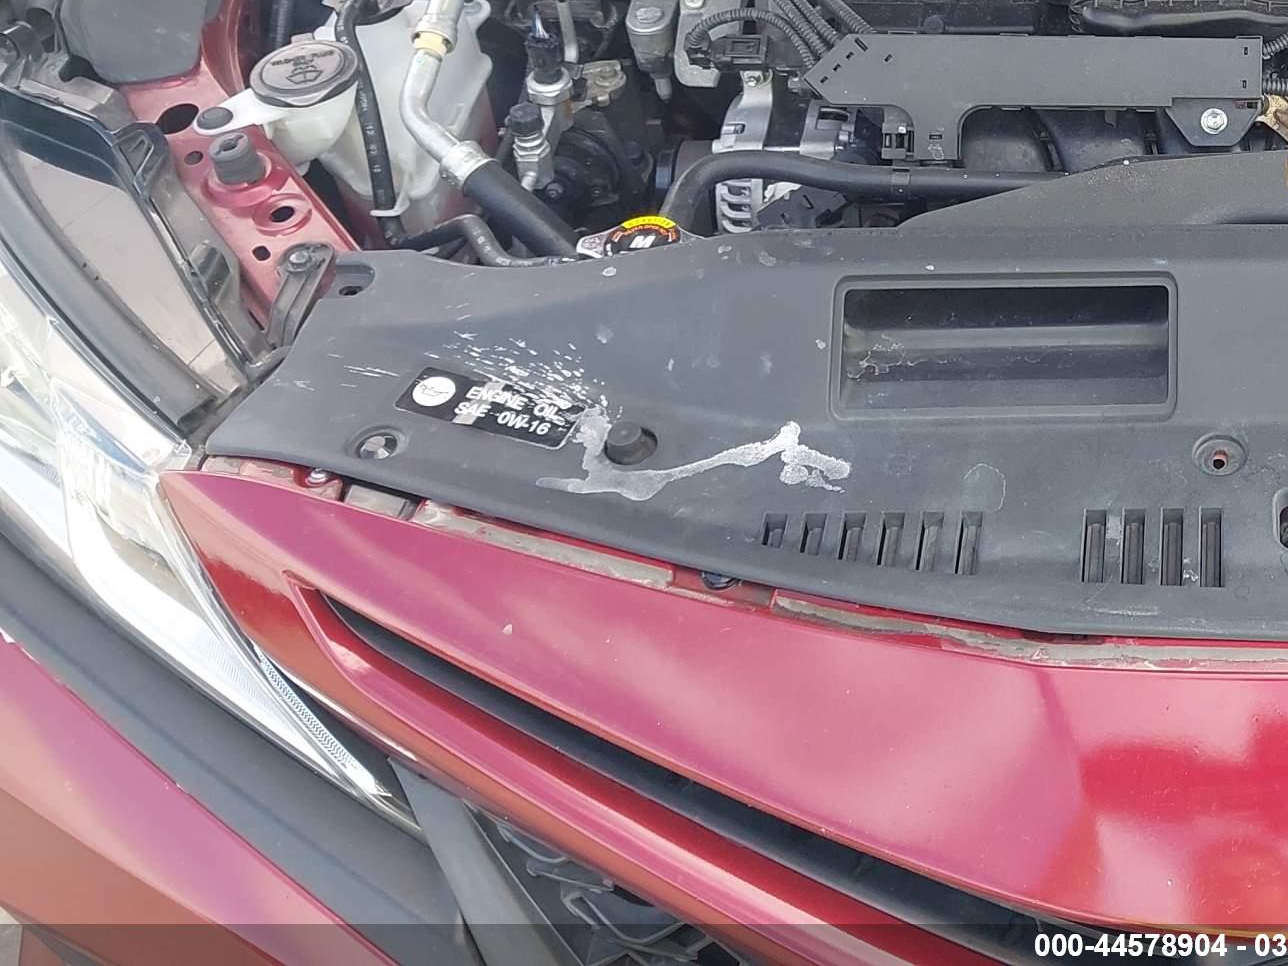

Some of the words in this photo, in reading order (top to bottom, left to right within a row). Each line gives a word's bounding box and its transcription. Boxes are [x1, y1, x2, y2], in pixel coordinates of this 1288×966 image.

[454, 401, 491, 418] SAE
[497, 411, 551, 435] 0W-16
[466, 386, 528, 411] ENGINE
[533, 402, 564, 425] OIL
